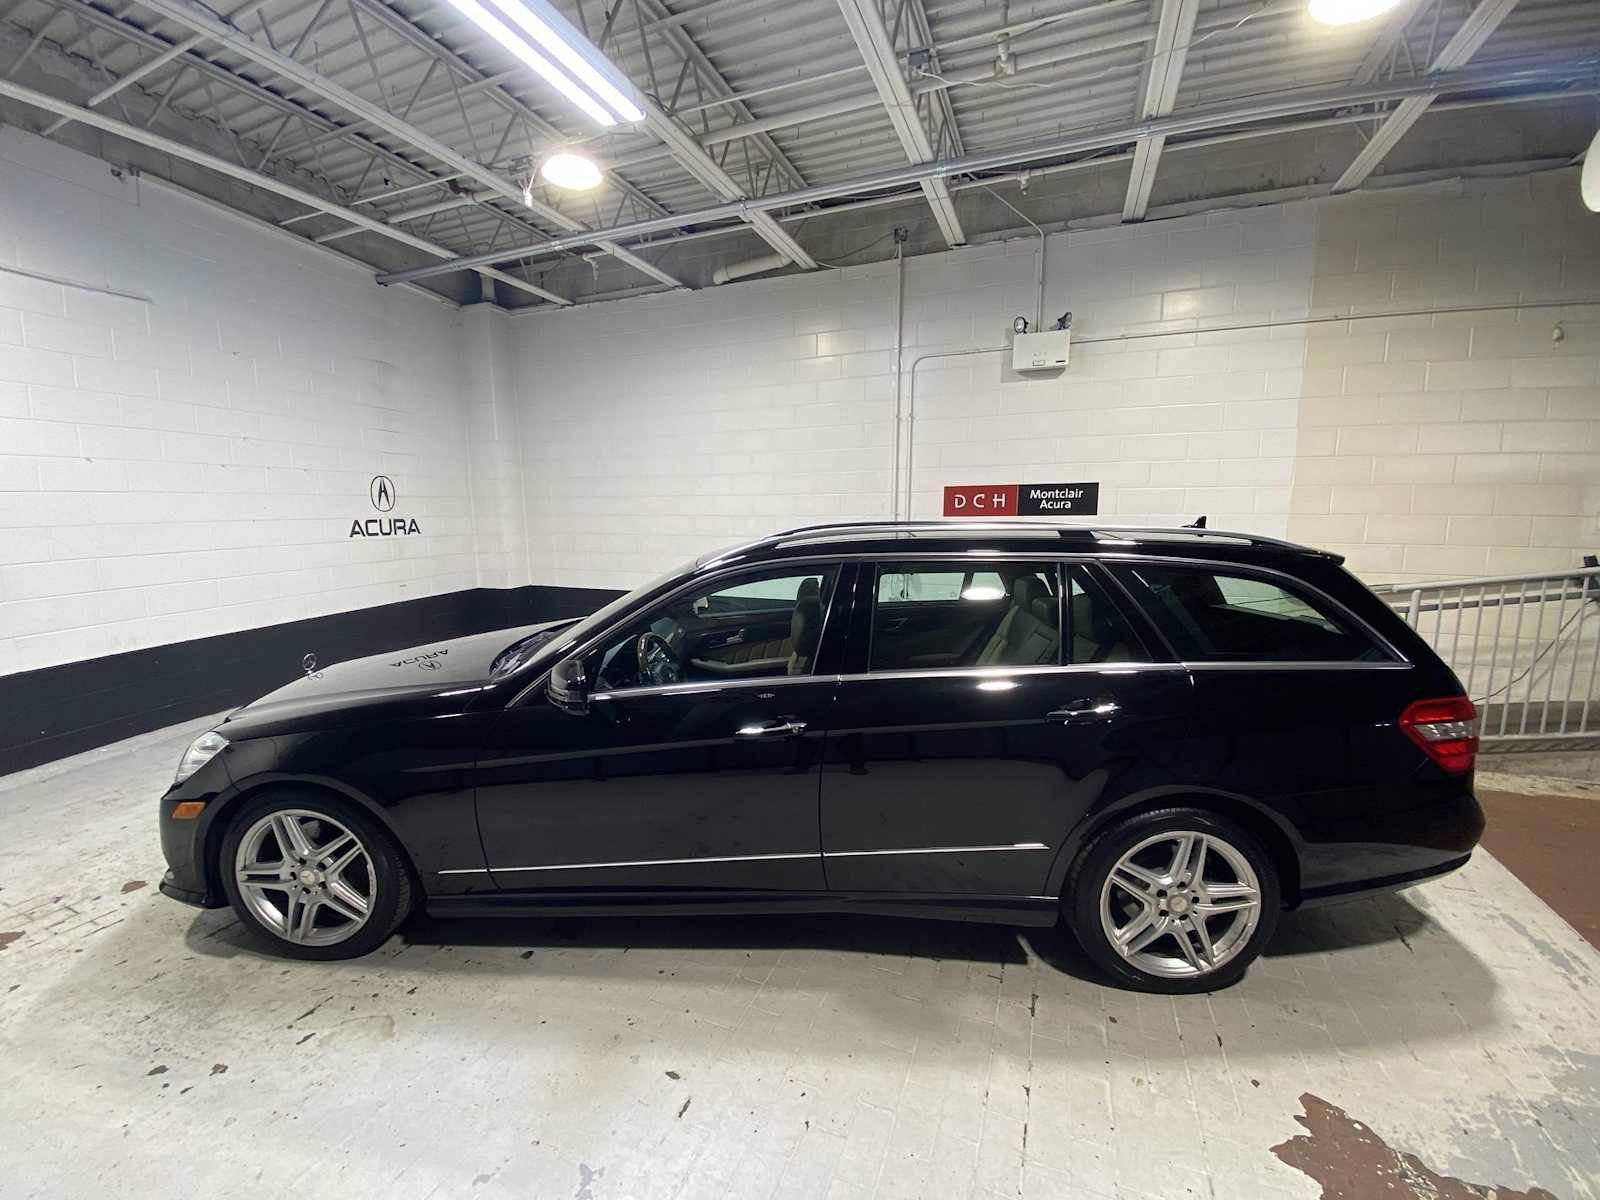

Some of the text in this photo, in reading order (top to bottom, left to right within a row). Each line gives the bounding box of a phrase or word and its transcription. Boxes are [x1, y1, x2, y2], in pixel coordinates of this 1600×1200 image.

[1030, 488, 1083, 500] Montclair
[1040, 499, 1071, 509] Acura
[349, 518, 420, 537] ACURA
